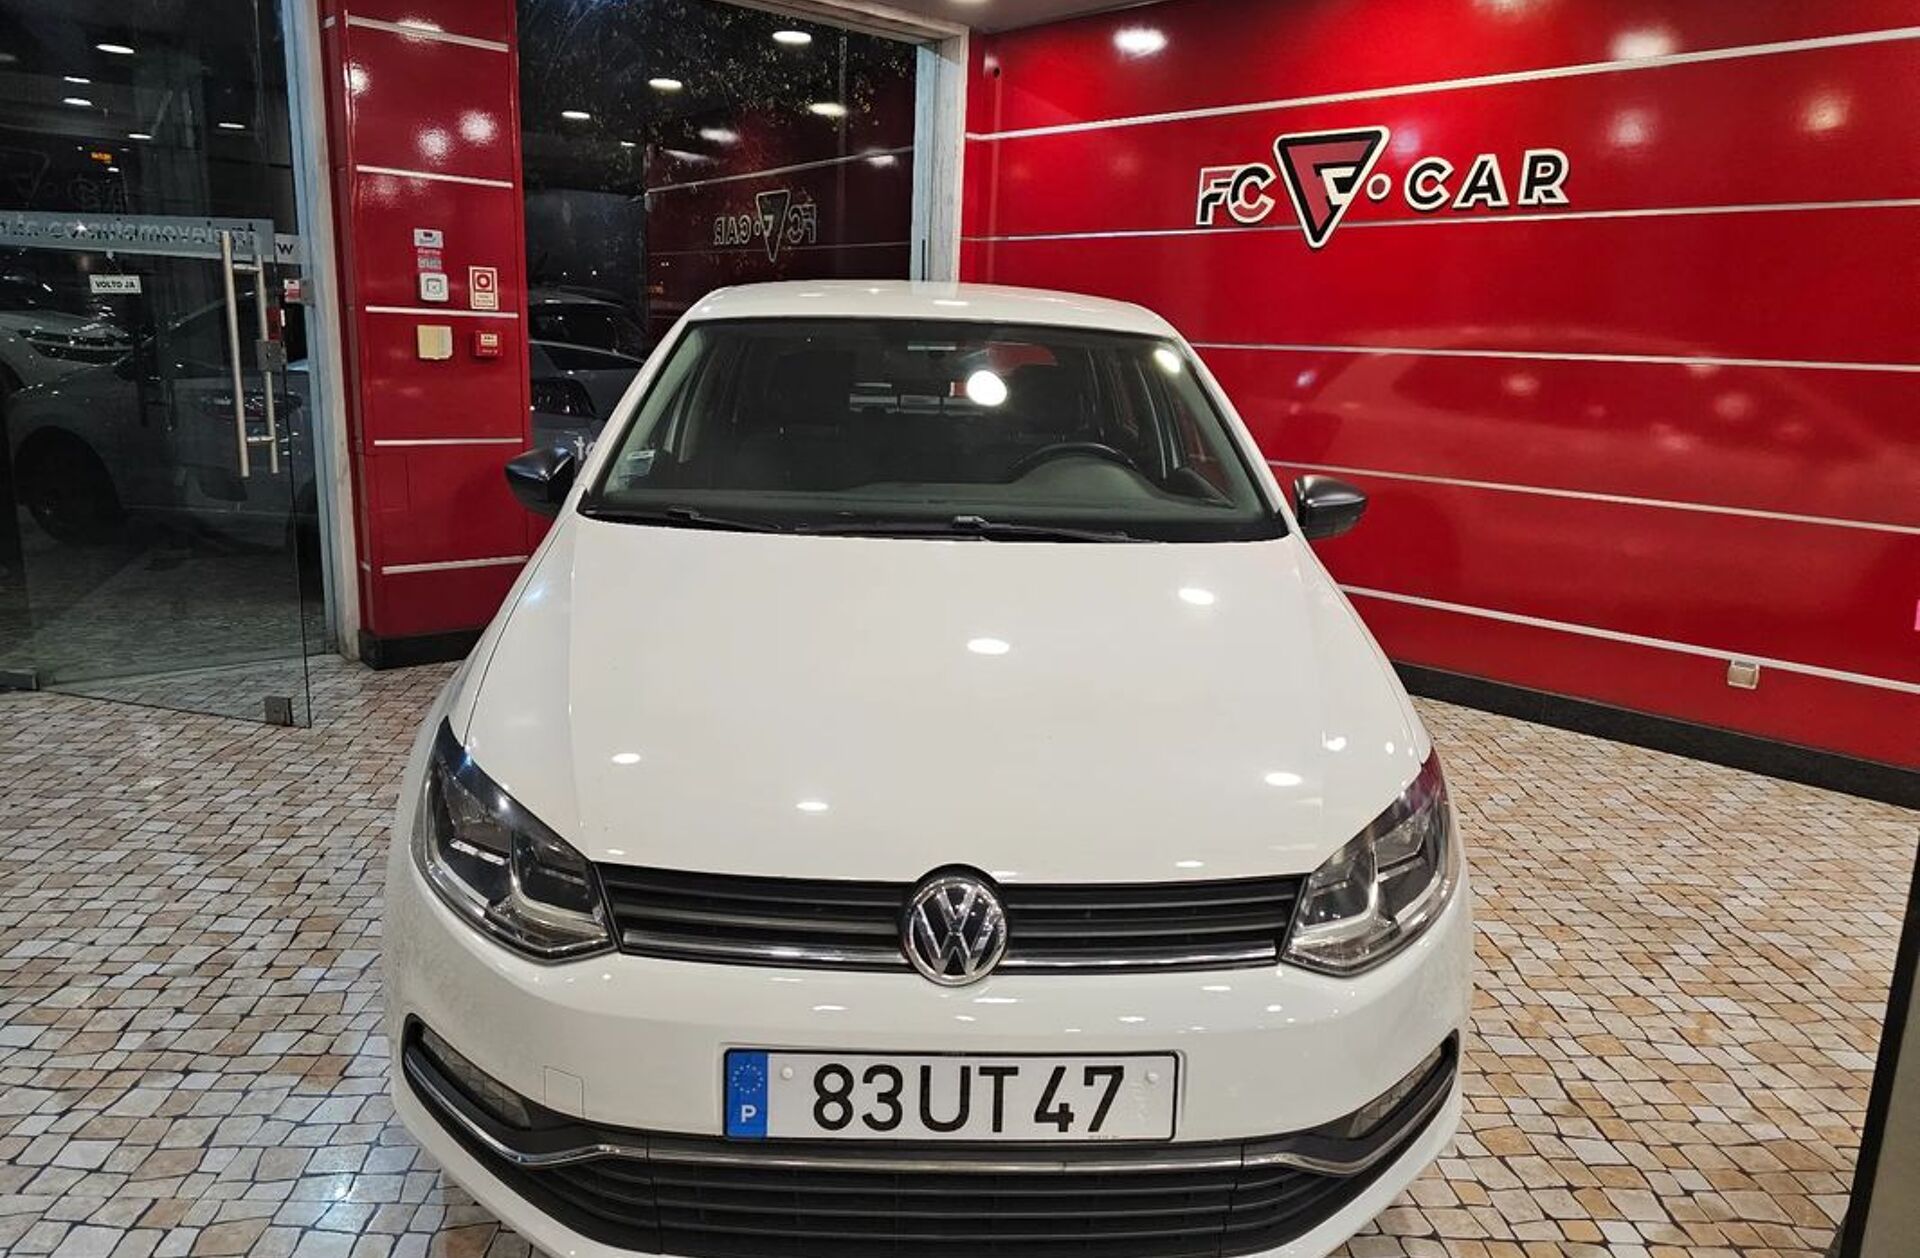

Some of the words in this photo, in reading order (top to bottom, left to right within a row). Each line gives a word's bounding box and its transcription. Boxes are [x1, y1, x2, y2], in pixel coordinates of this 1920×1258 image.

[1196, 163, 1277, 226] FC
[1403, 148, 1571, 212] CAR
[95, 280, 123, 289] VOLTO
[741, 1105, 757, 1123] P
